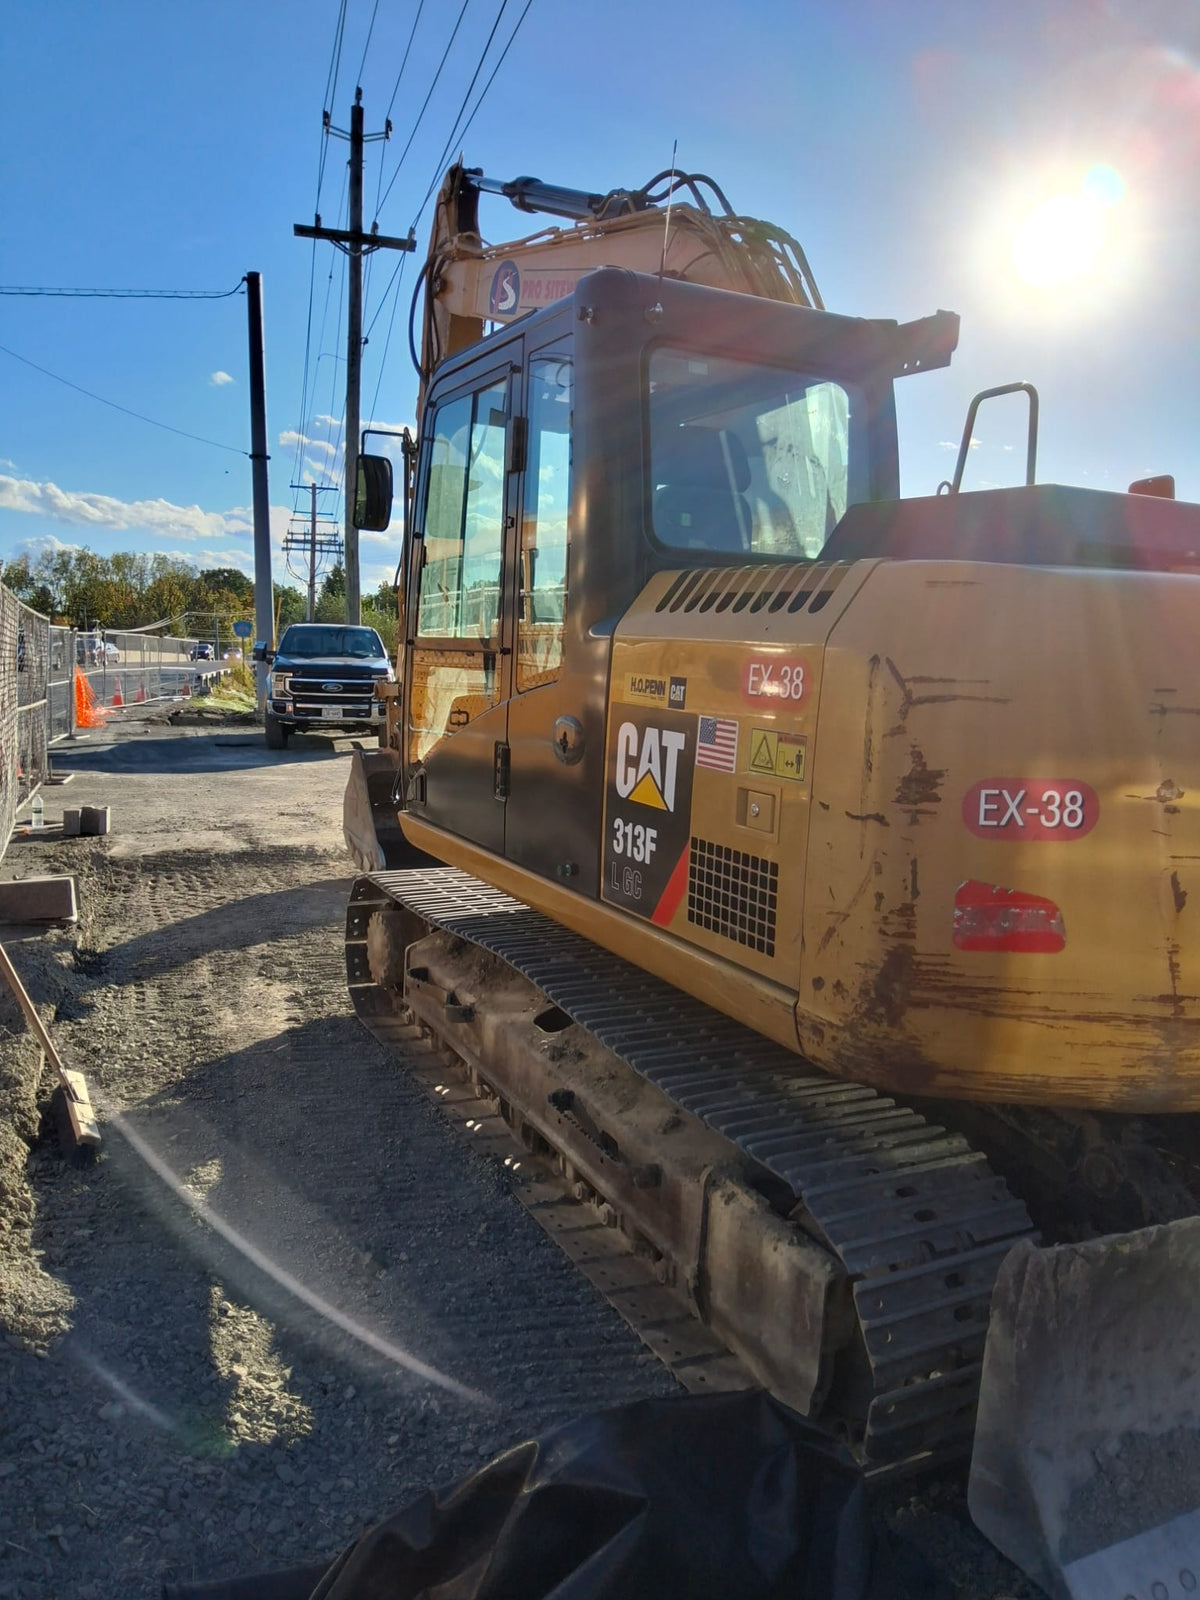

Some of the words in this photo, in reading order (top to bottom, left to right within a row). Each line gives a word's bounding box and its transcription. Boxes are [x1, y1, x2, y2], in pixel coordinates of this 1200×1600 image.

[521, 279, 542, 299] PRO
[670, 685, 686, 701] CAT
[748, 664, 804, 700] EX-38
[615, 722, 686, 813] CAT
[978, 789, 1083, 828] EX-38
[612, 818, 658, 865] 313F
[611, 861, 620, 890] L
[622, 866, 643, 900] GC
